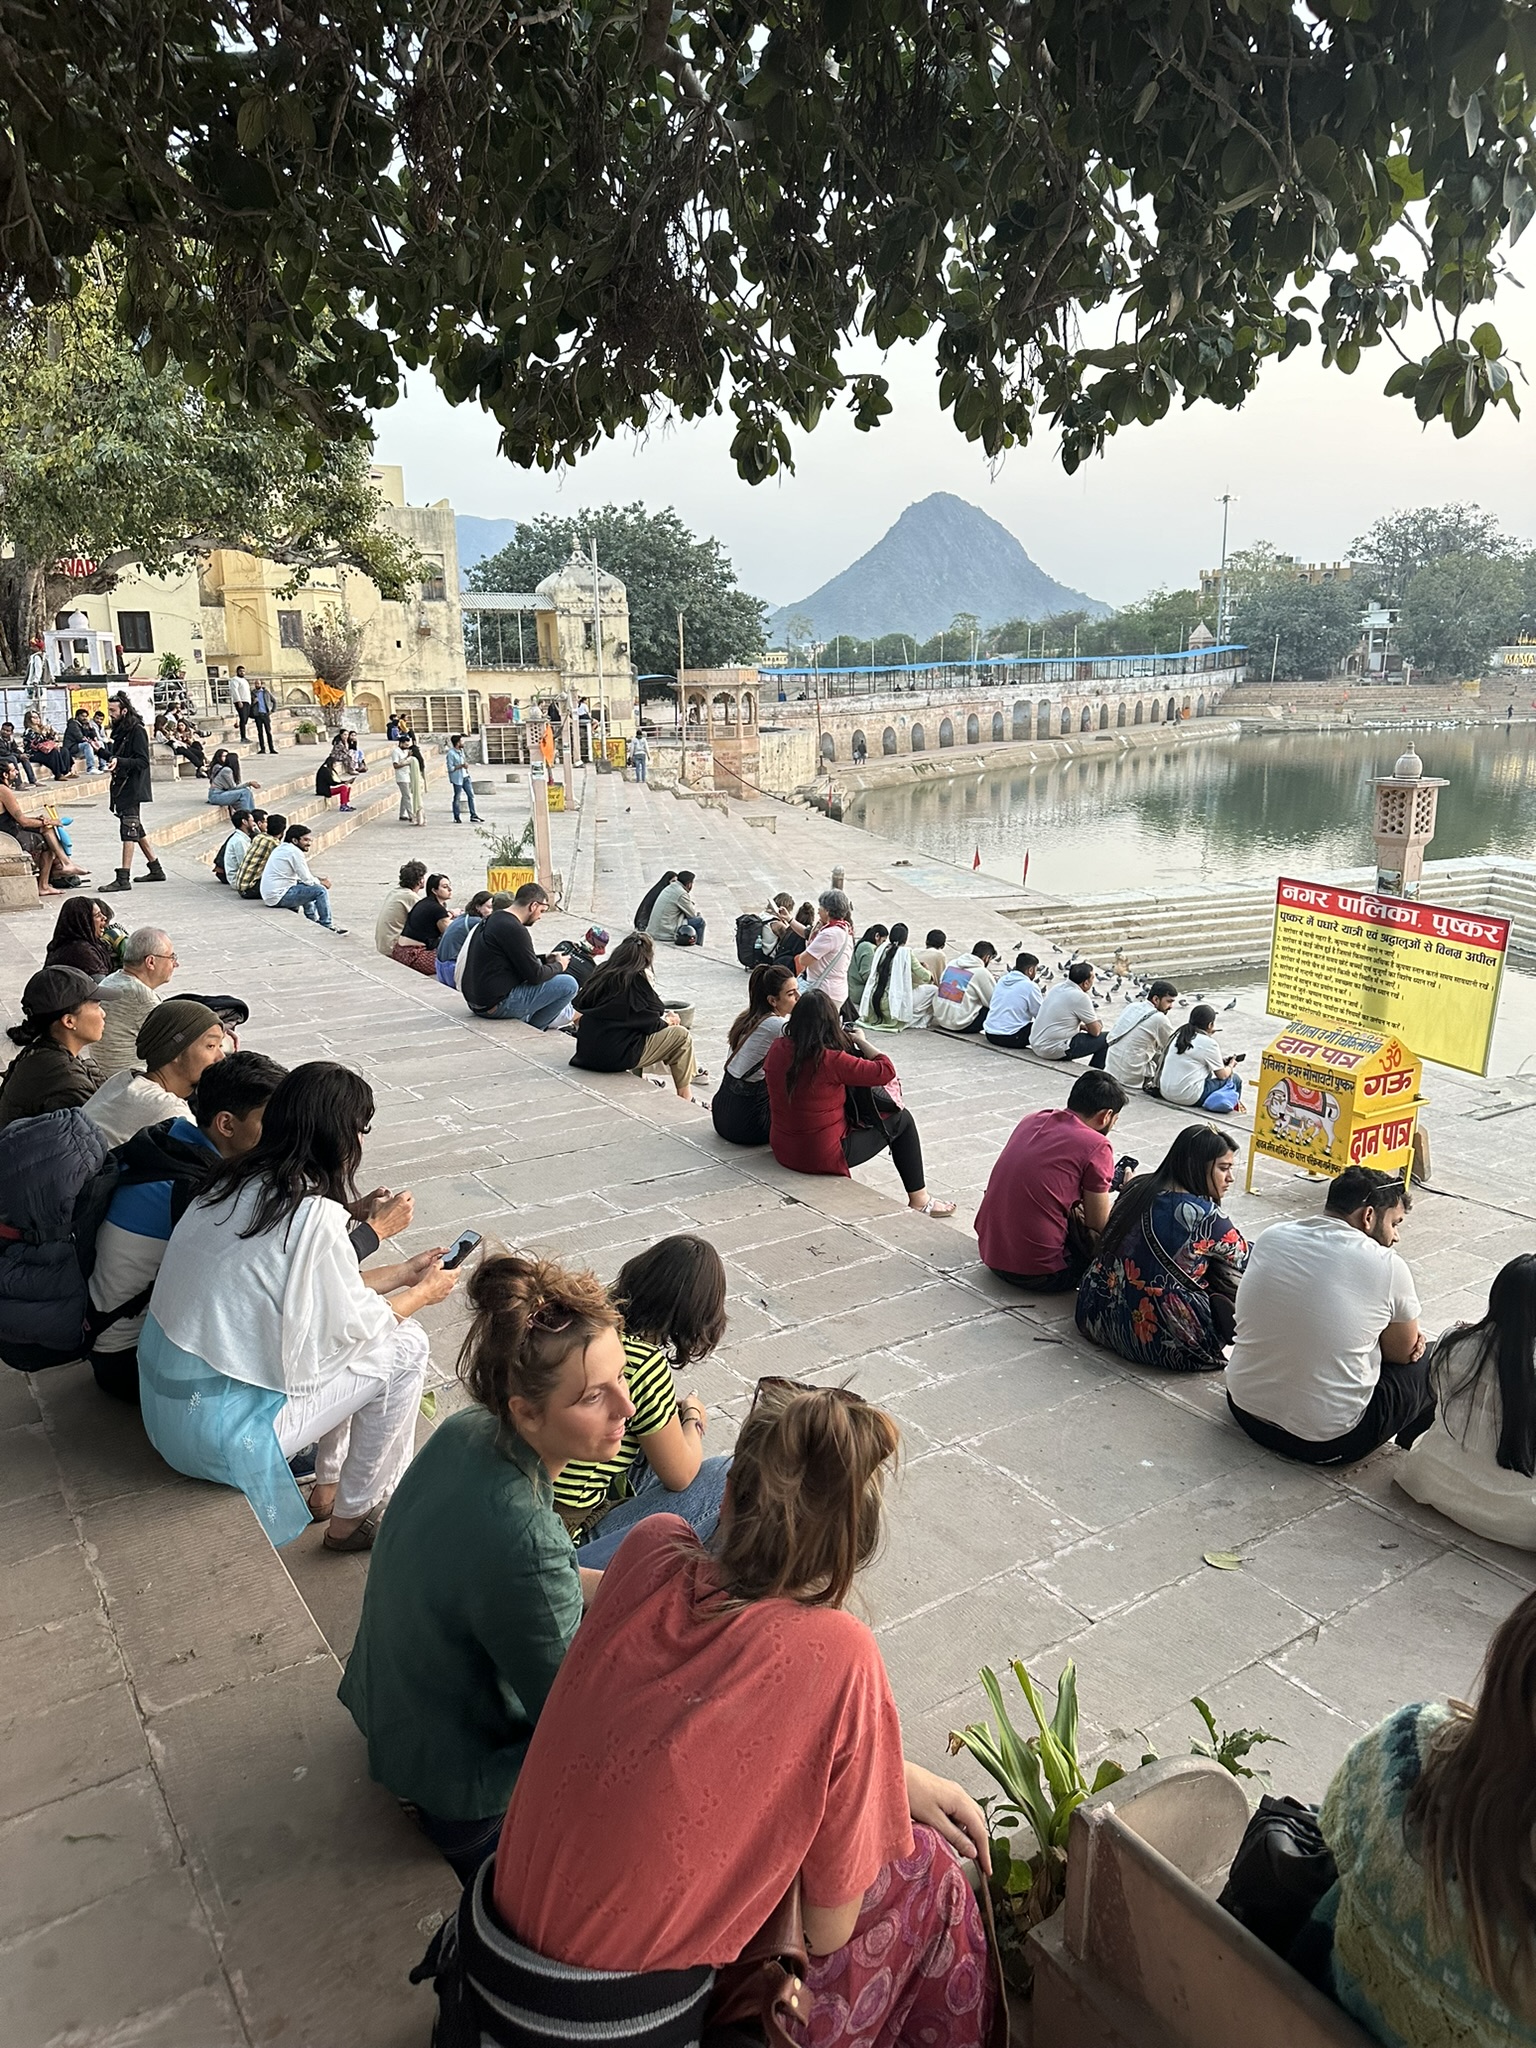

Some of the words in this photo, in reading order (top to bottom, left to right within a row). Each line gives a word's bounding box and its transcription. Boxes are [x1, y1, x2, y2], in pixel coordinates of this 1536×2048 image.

[1282, 884, 1332, 909] नगर
[1337, 894, 1422, 928] पालिका,
[1432, 912, 1504, 944] पुष्कर
[1280, 911, 1304, 924] पुष्कर
[1306, 915, 1314, 926] में
[1341, 924, 1363, 936] यात्री
[1366, 929, 1378, 940] एवं
[1423, 940, 1433, 952] से
[1435, 942, 1462, 959] विनम्र
[1465, 951, 1497, 966] अपील
[1276, 1036, 1322, 1058] दान
[1321, 1046, 1364, 1069] पात्र
[1262, 1055, 1286, 1073] एनिमल
[1334, 1076, 1355, 1095] पुष्कर
[1364, 1068, 1414, 1096] गऊ
[1350, 1123, 1383, 1164] दान
[1382, 1116, 1414, 1151] पात्र
